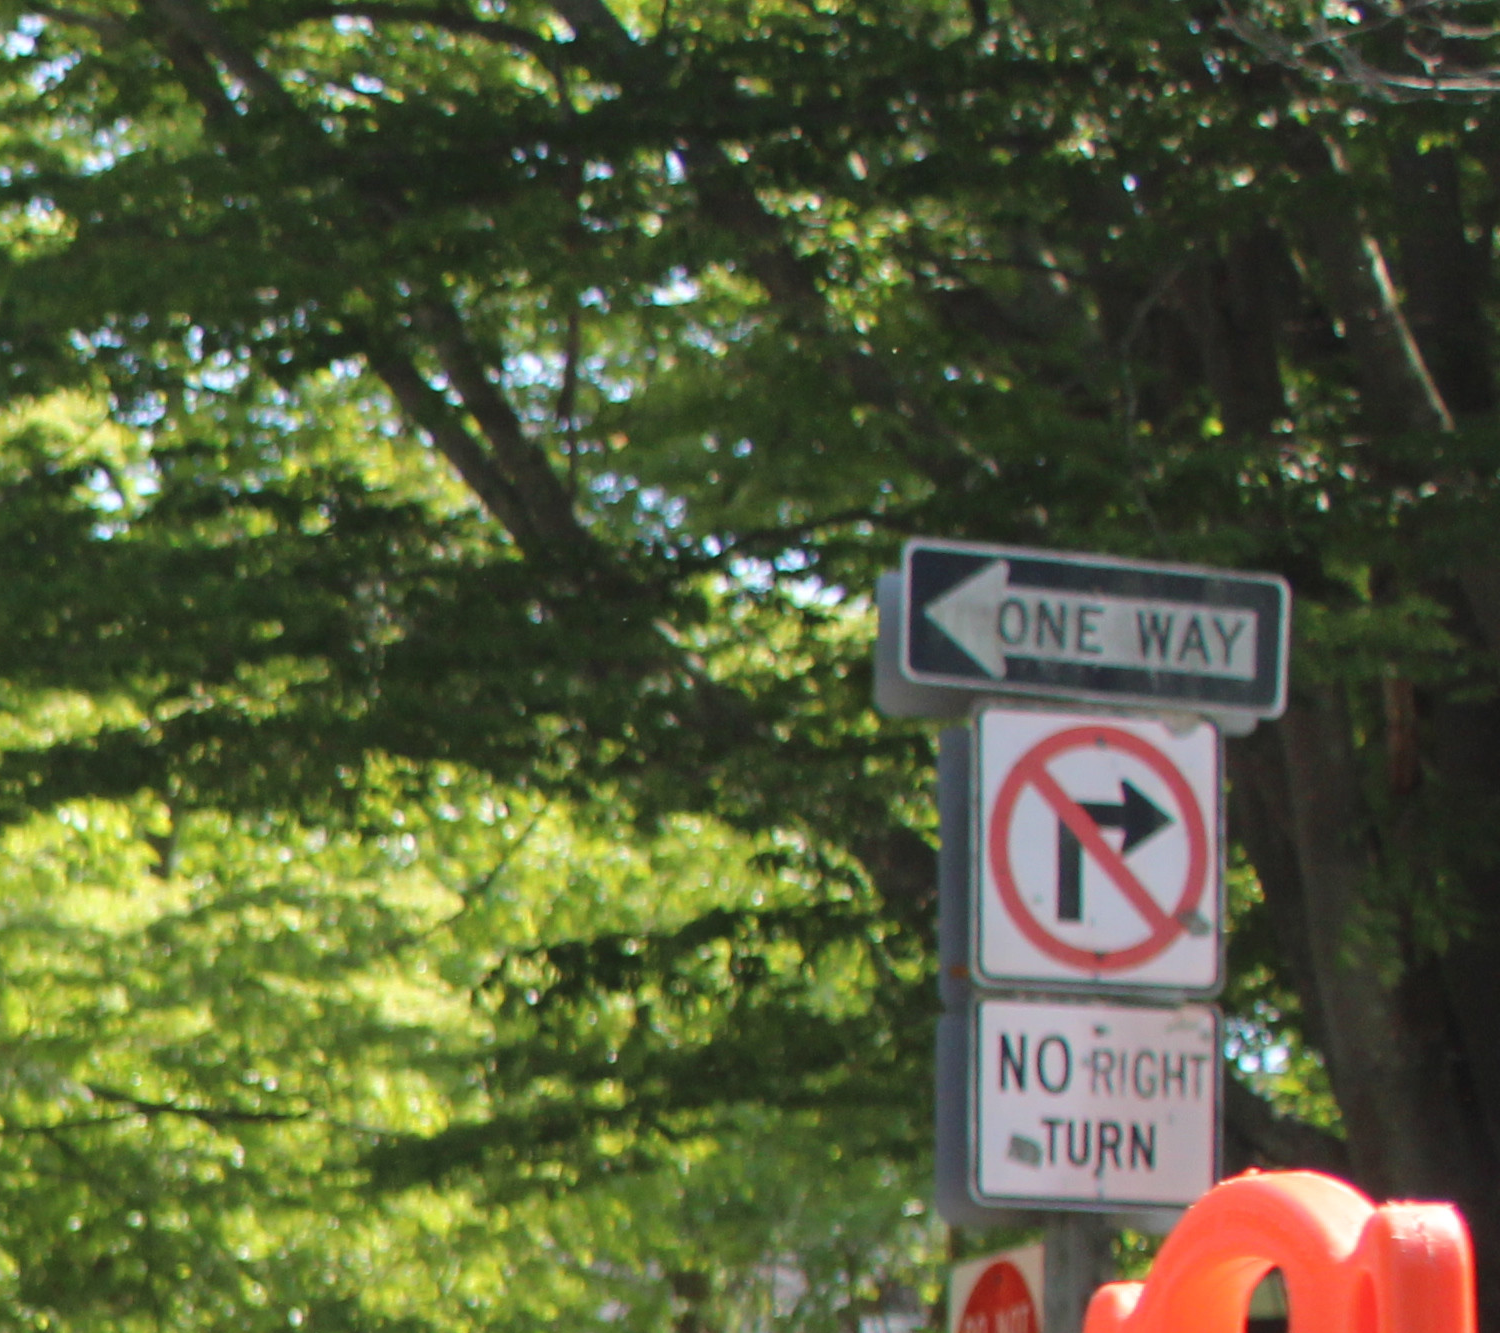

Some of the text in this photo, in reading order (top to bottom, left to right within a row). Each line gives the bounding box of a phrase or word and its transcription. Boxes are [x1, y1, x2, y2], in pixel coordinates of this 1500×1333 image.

[997, 597, 1246, 667] ONE WAY
[999, 1032, 1210, 1099] NO RIGHT
[1041, 1116, 1157, 1171] TURN
